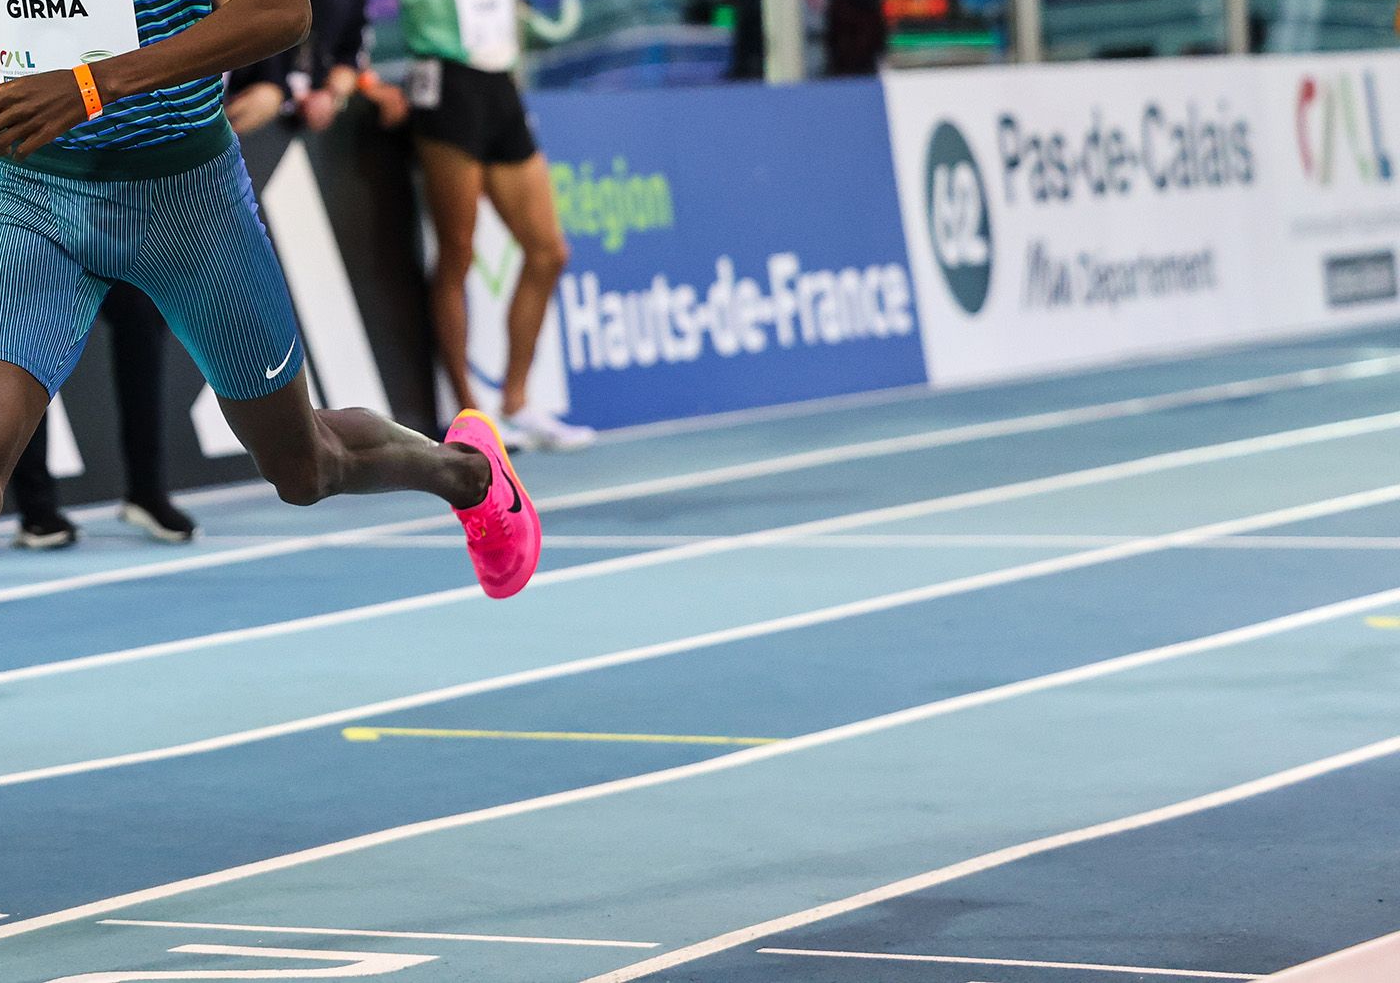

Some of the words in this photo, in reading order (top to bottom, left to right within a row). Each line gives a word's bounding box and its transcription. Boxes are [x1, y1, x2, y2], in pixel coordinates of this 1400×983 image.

[551, 156, 676, 252] Région
[997, 99, 1257, 207] Pas-de-Calais
[560, 252, 915, 371] Hauts-de-France
